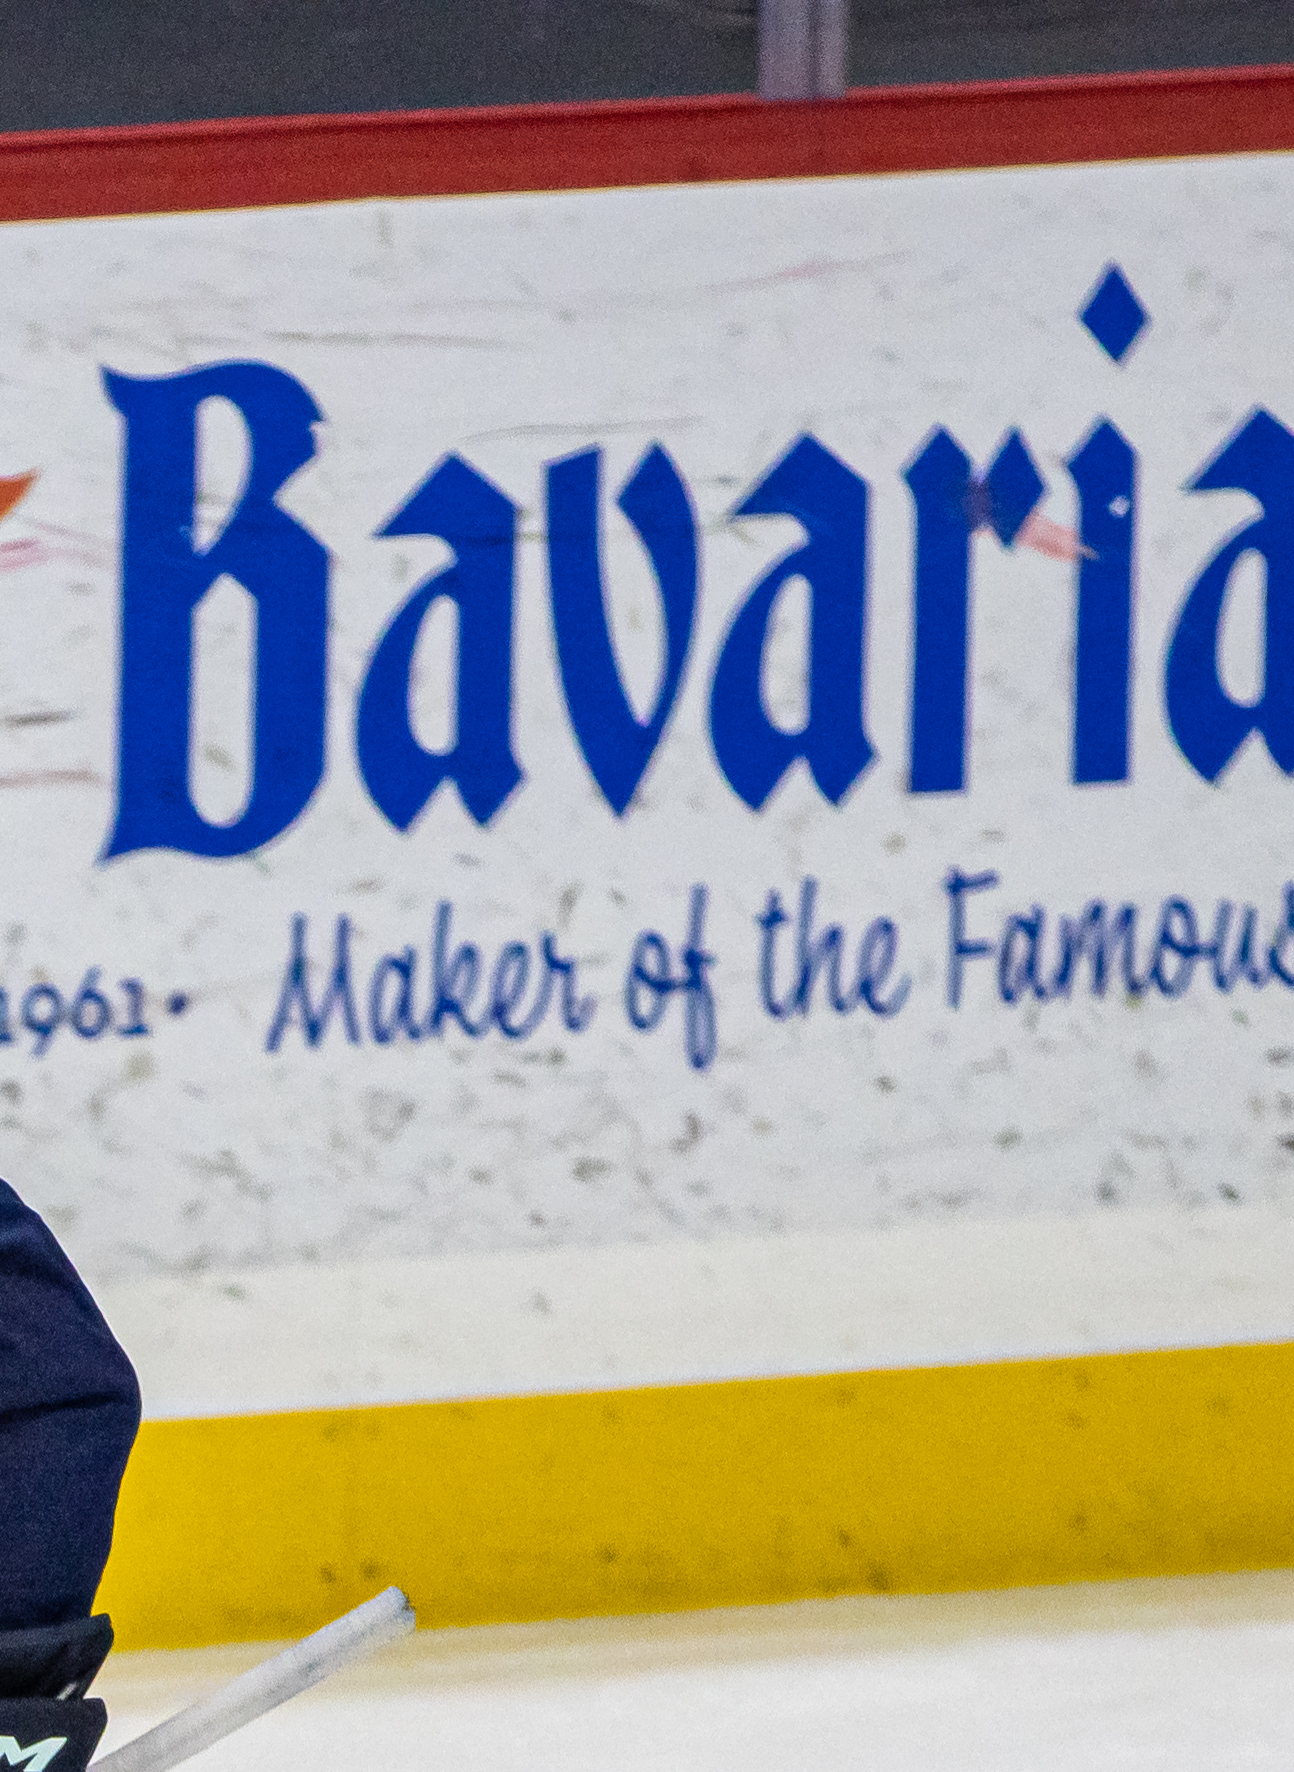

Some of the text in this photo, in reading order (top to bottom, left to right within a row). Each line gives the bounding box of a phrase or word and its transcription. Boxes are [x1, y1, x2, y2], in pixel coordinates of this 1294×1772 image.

[94, 262, 1294, 866] Bavaria
[264, 899, 598, 1054] Maker
[624, 882, 716, 1073] of
[755, 873, 913, 1020] the
